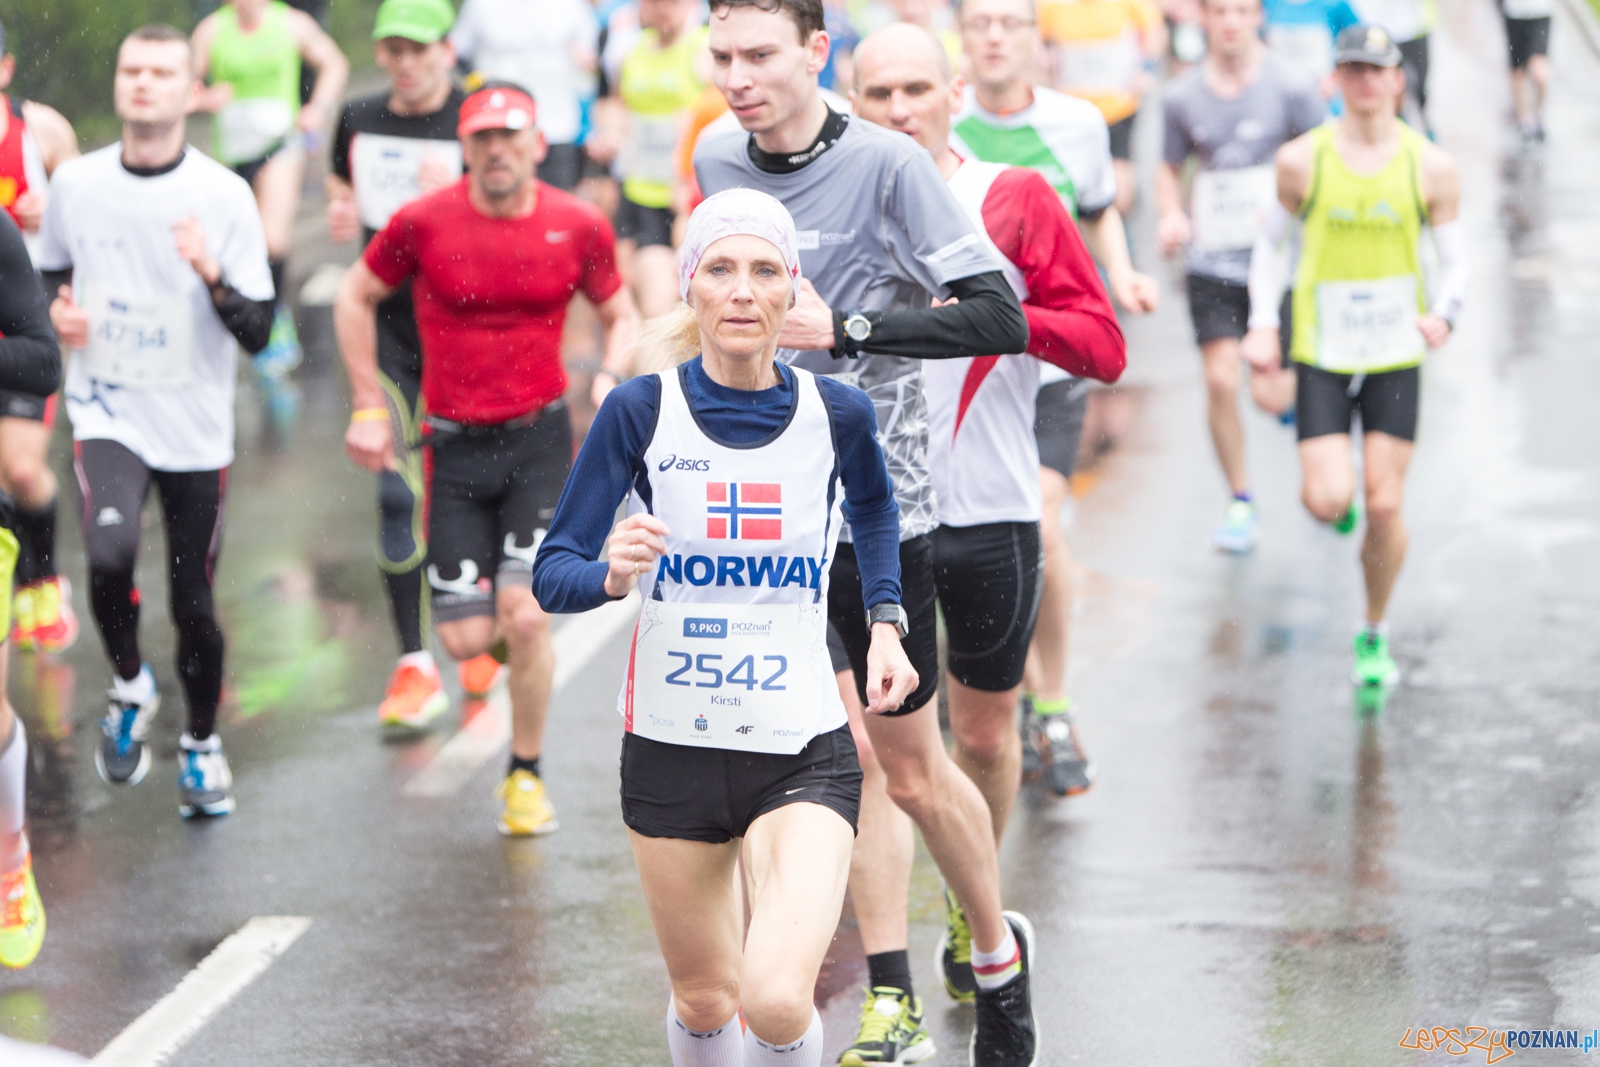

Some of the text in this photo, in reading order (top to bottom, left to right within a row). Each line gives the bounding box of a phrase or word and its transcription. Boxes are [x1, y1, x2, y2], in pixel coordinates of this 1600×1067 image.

[657, 553, 828, 589] NORWAY
[689, 622, 698, 633] 9.
[699, 623, 722, 634] PKO
[665, 651, 788, 691] 2542
[711, 695, 742, 706] Kirsti
[735, 725, 754, 735] 4F
